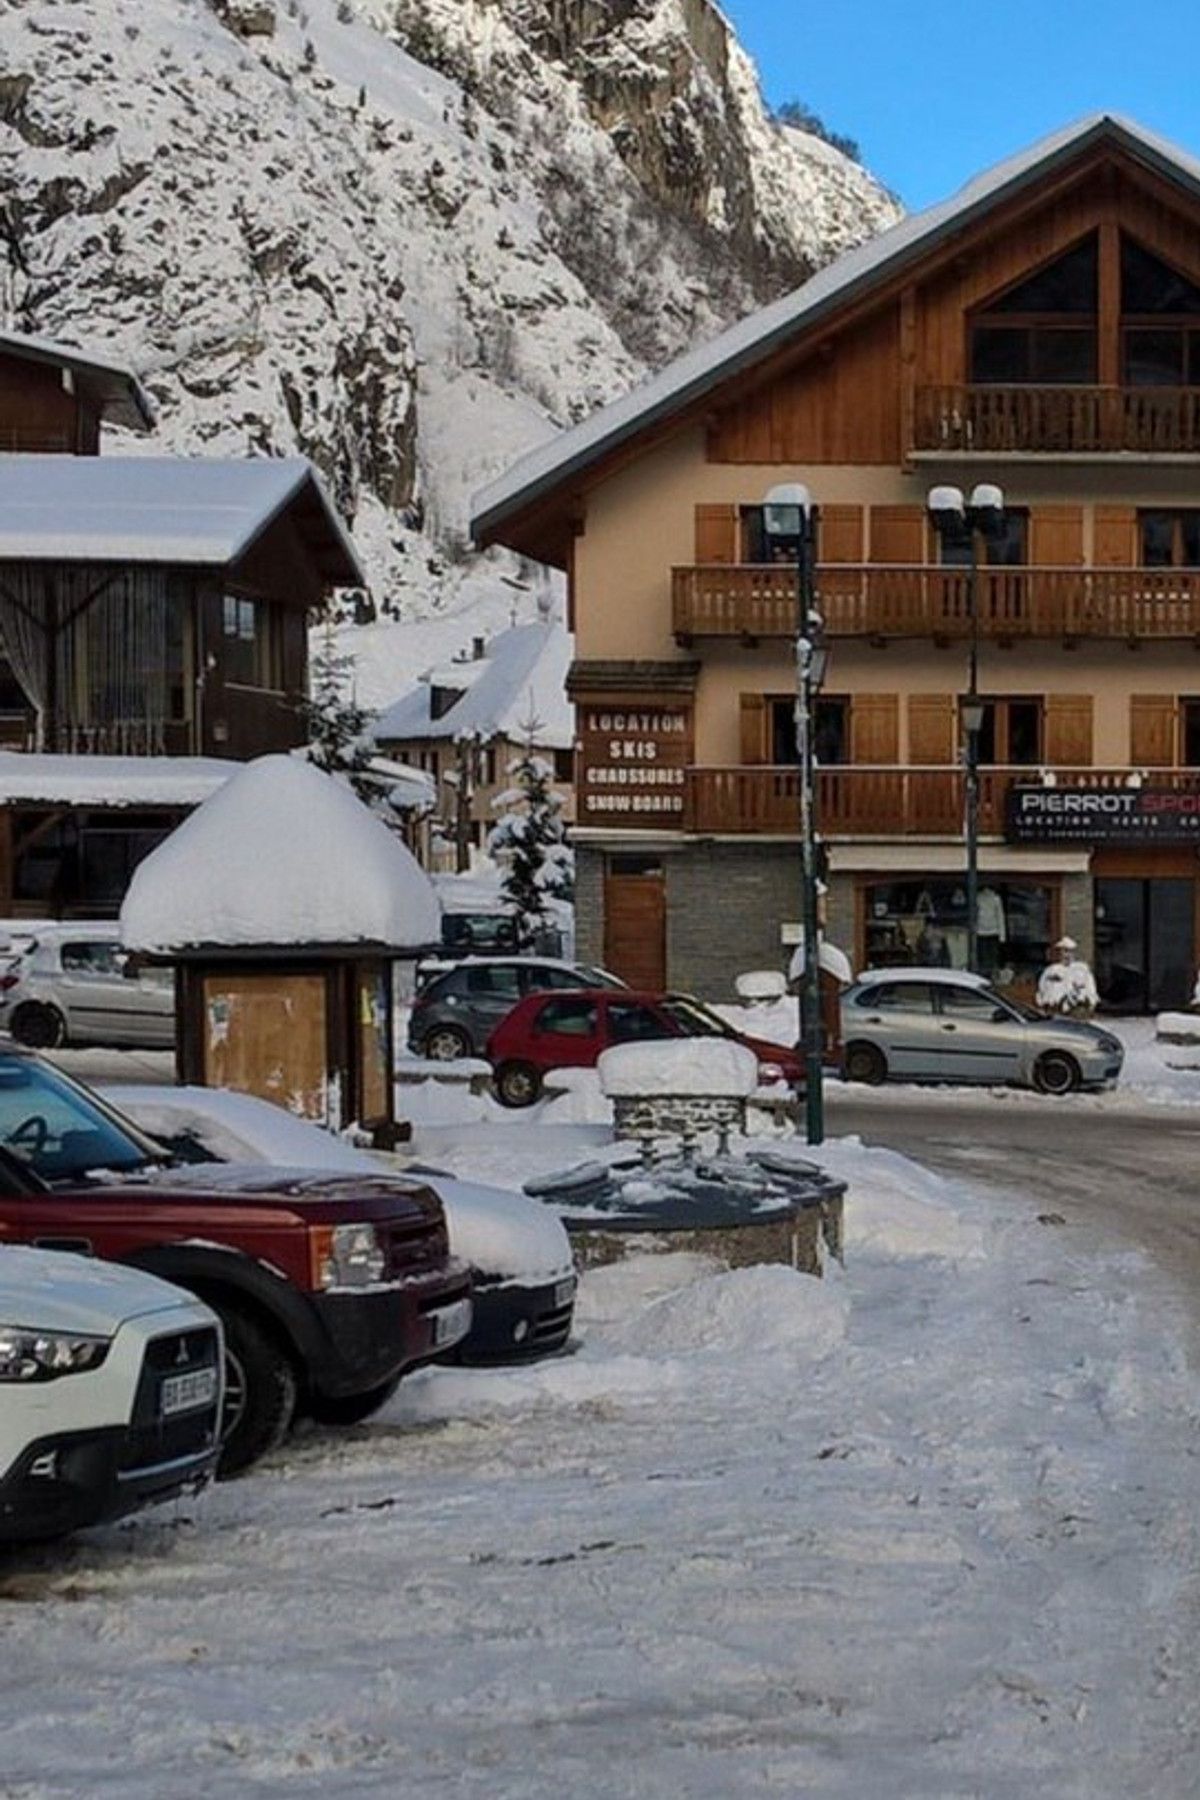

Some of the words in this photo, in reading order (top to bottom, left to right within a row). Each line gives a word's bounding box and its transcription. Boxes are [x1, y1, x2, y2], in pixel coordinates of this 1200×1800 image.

[589, 714, 684, 731] LOCATION
[609, 740, 656, 759] SKIS
[587, 768, 684, 784] CHAUSSURES
[1022, 794, 1136, 812] PIERROT
